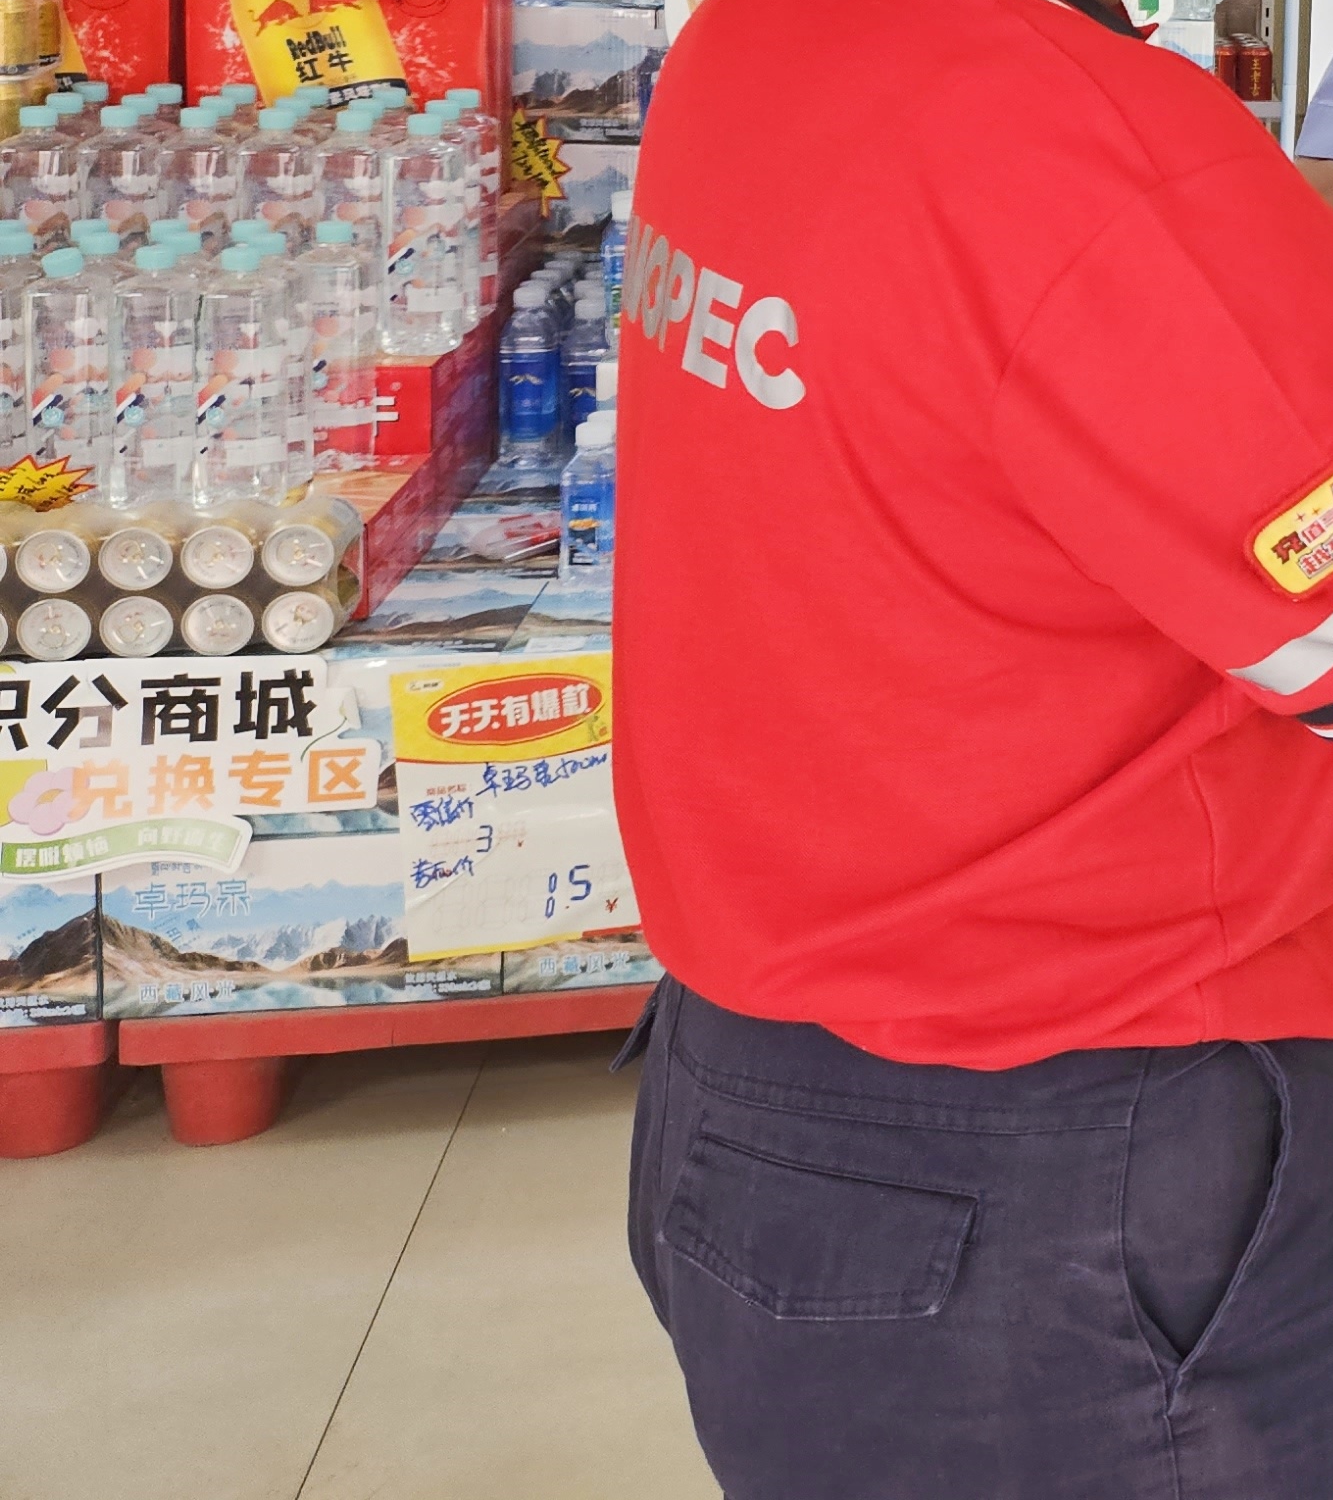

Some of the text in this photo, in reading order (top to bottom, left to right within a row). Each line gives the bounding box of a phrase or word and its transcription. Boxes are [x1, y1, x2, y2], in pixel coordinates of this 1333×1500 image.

[294, 51, 354, 84] 红牛
[439, 682, 593, 737] 天天有爆款
[67, 748, 367, 818] 兑换专区
[133, 878, 251, 921] 卓玛泉
